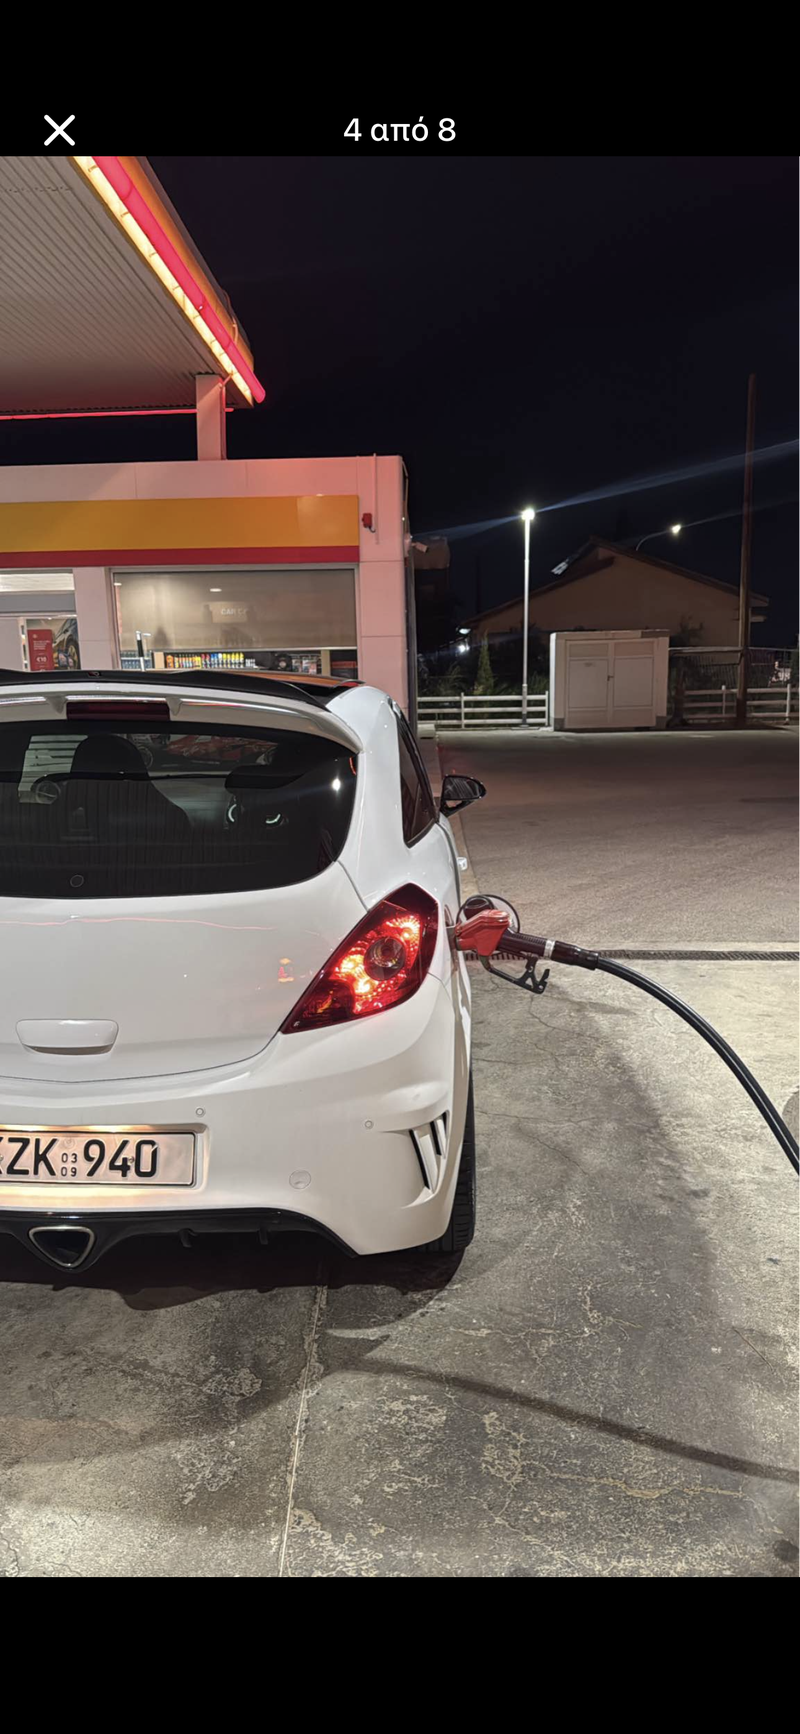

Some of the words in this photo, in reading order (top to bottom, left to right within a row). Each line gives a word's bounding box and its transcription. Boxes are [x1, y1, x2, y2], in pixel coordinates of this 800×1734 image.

[0, 1137, 58, 1177] ZK
[83, 1139, 158, 1178] 940
[61, 1152, 78, 1164] 03
[60, 1166, 78, 1177] 09
